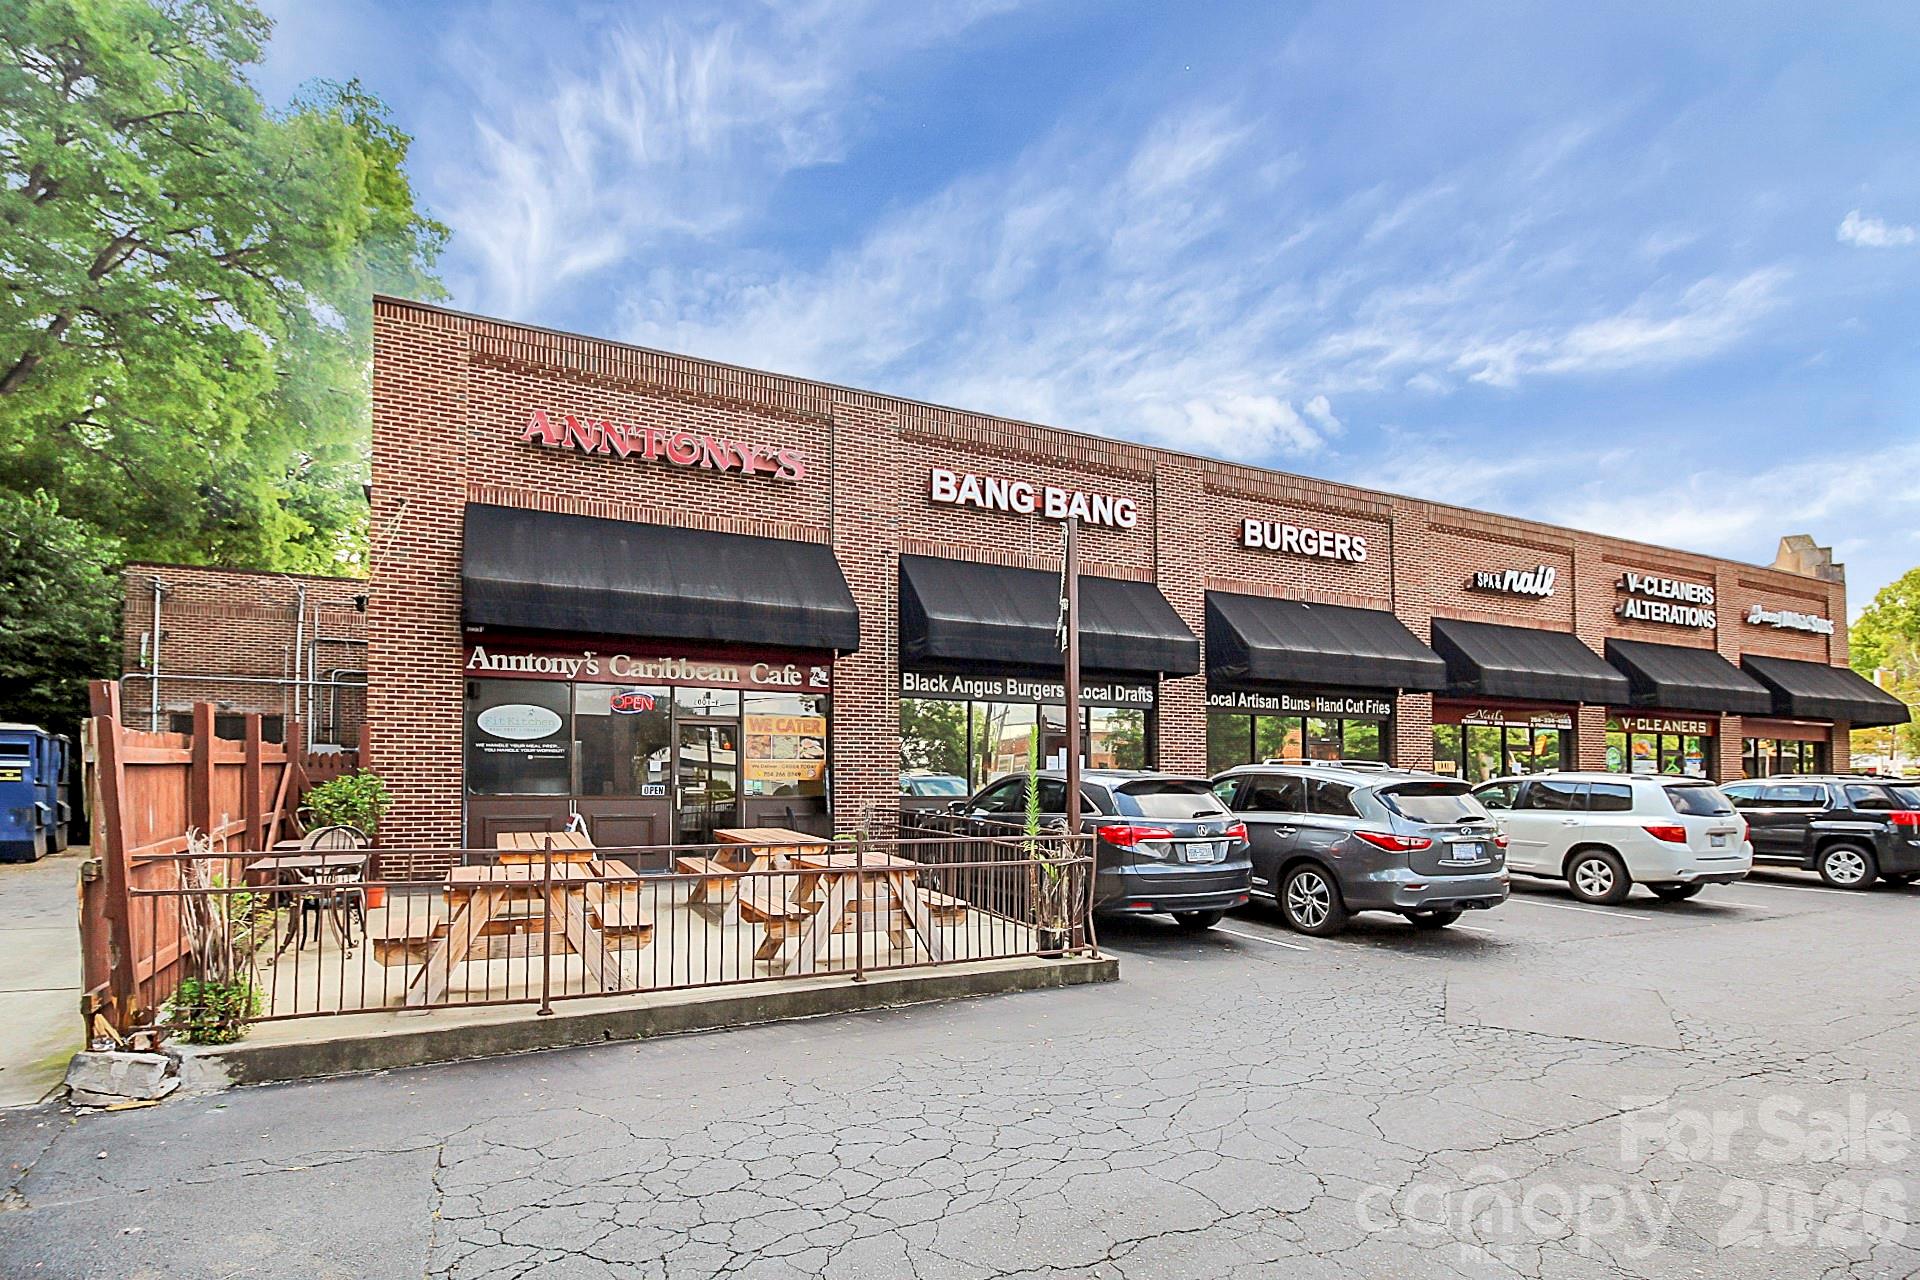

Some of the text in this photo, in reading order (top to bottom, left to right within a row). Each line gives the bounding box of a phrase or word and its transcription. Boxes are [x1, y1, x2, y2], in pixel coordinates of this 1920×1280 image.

[520, 410, 806, 481] ANNTONY'S
[931, 468, 1138, 528] BANG BANG
[1244, 518, 1367, 562] BURGERS
[1502, 565, 1556, 597] nail
[1626, 572, 1715, 606] V-CLEANERS
[1625, 598, 1717, 629] ALTERATIONS
[466, 645, 802, 686] Anntony's Caribbean Cafe
[903, 672, 949, 693] Black
[951, 675, 1002, 698] Angus
[1006, 678, 1065, 701] Burgers
[1115, 685, 1153, 702] Drafts
[610, 695, 655, 711] OPEN
[1205, 691, 1391, 715] Local Artisan Buns Hand Cut Fries
[749, 718, 822, 734] WE CATER
[1621, 717, 1707, 733] V-CLEANERS
[643, 786, 664, 795] OPEN
